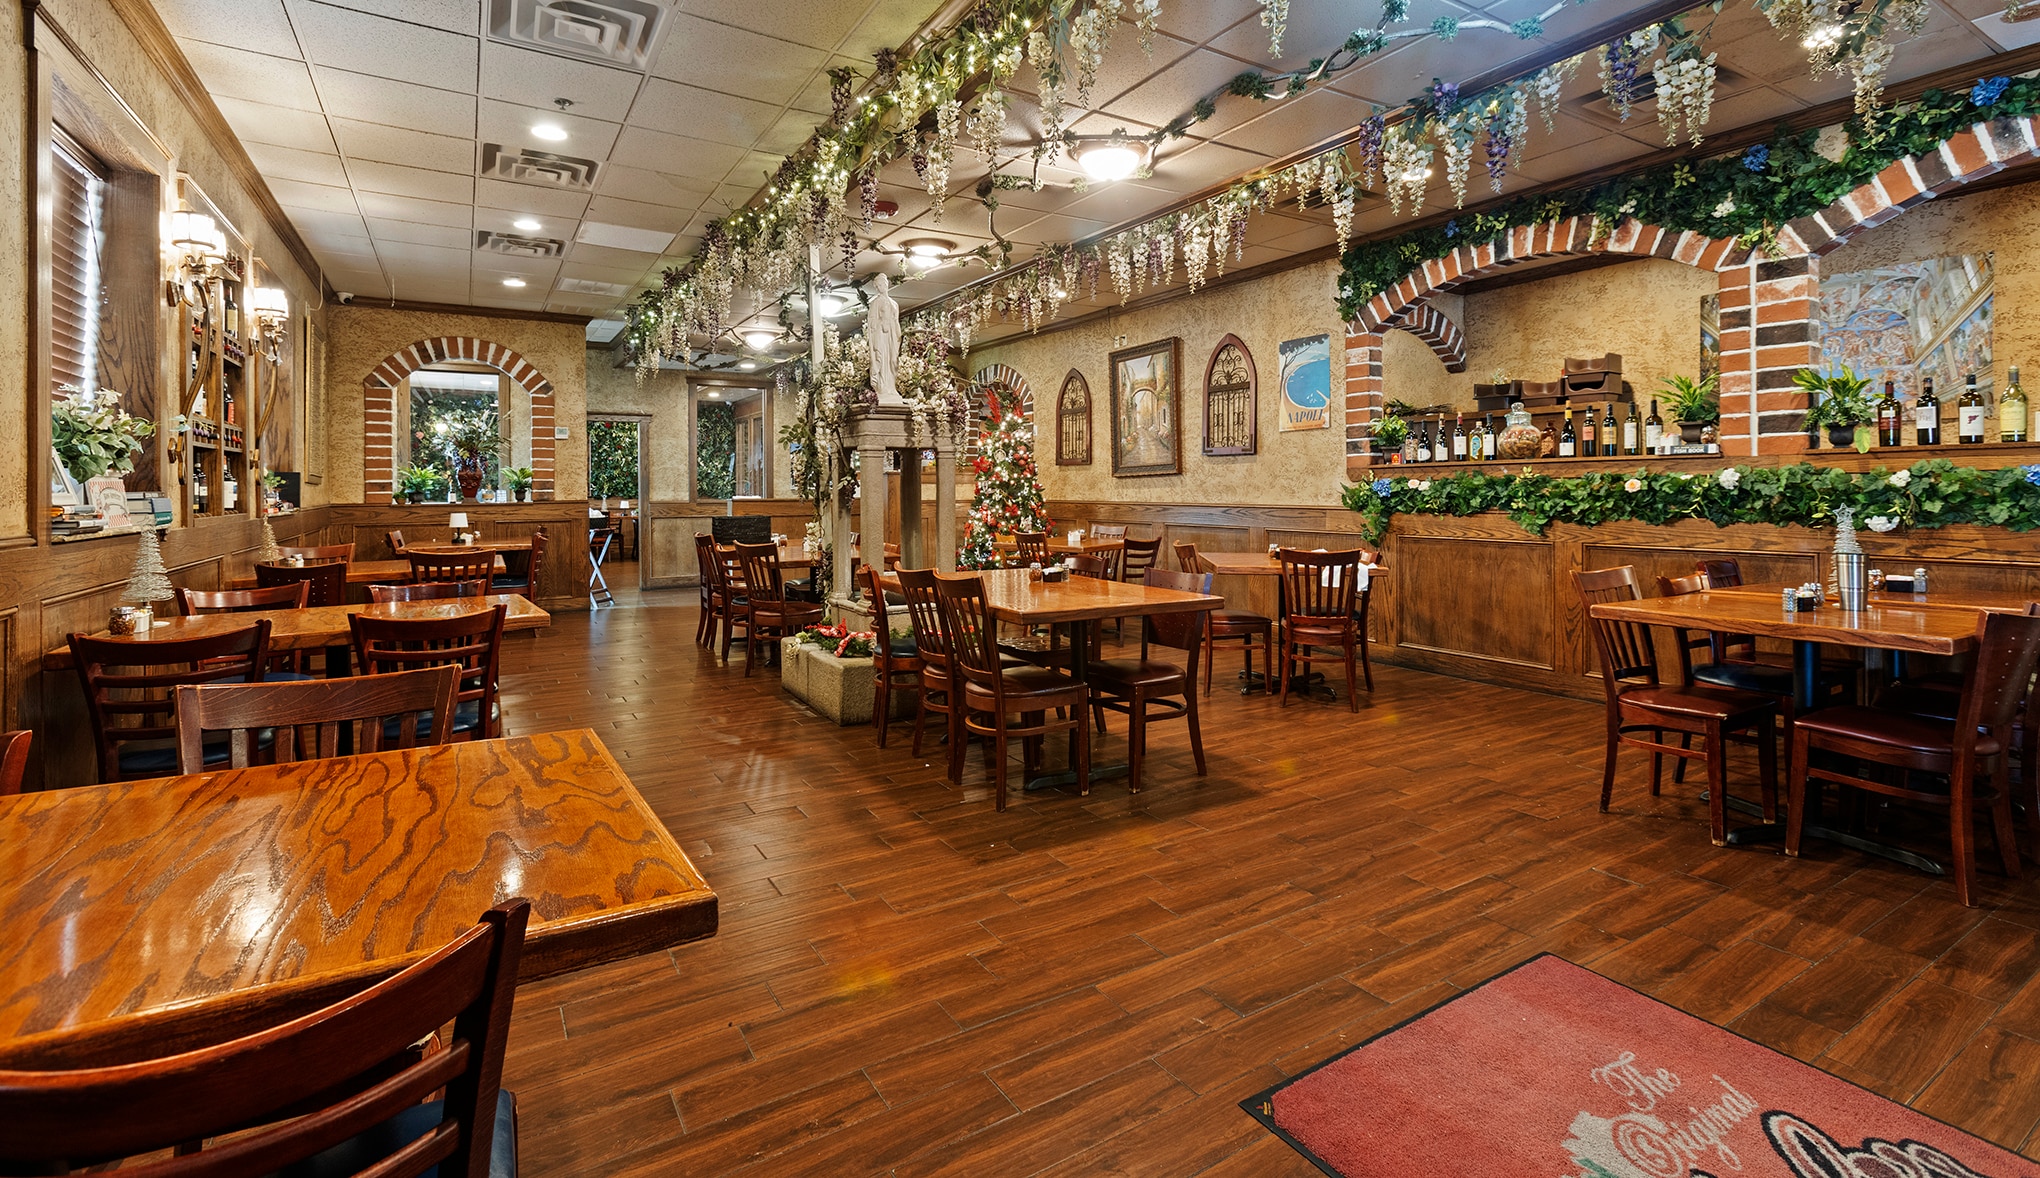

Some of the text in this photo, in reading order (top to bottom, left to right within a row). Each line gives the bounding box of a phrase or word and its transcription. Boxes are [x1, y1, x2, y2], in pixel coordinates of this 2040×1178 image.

[1288, 409, 1323, 423] NAPOLI
[1590, 1051, 1681, 1112] The
[1613, 1073, 1759, 1178] Original
